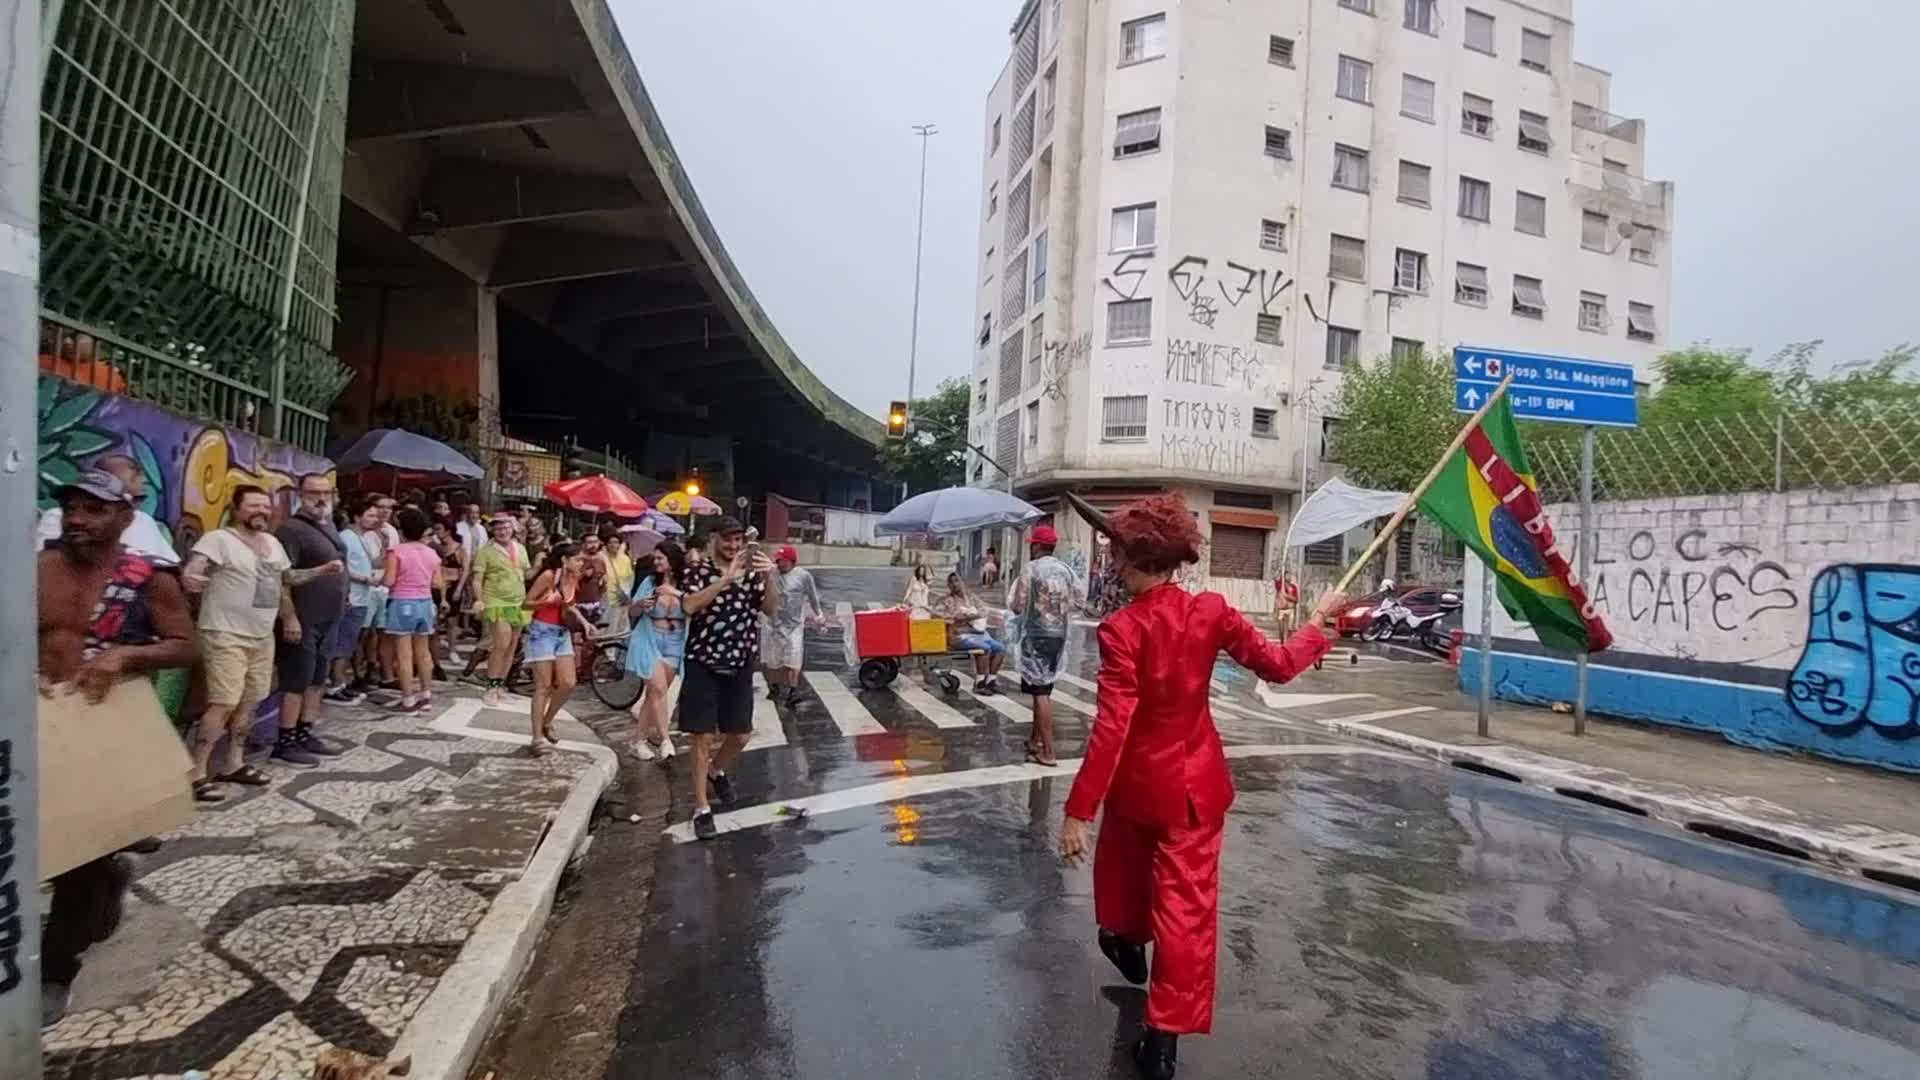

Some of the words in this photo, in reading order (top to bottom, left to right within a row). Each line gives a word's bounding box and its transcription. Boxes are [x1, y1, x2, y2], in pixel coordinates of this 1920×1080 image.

[1505, 363, 1541, 381] Hosp.
[1545, 367, 1569, 382] Sta.
[1572, 370, 1630, 389] Maggiore
[1546, 397, 1575, 411] BPM
